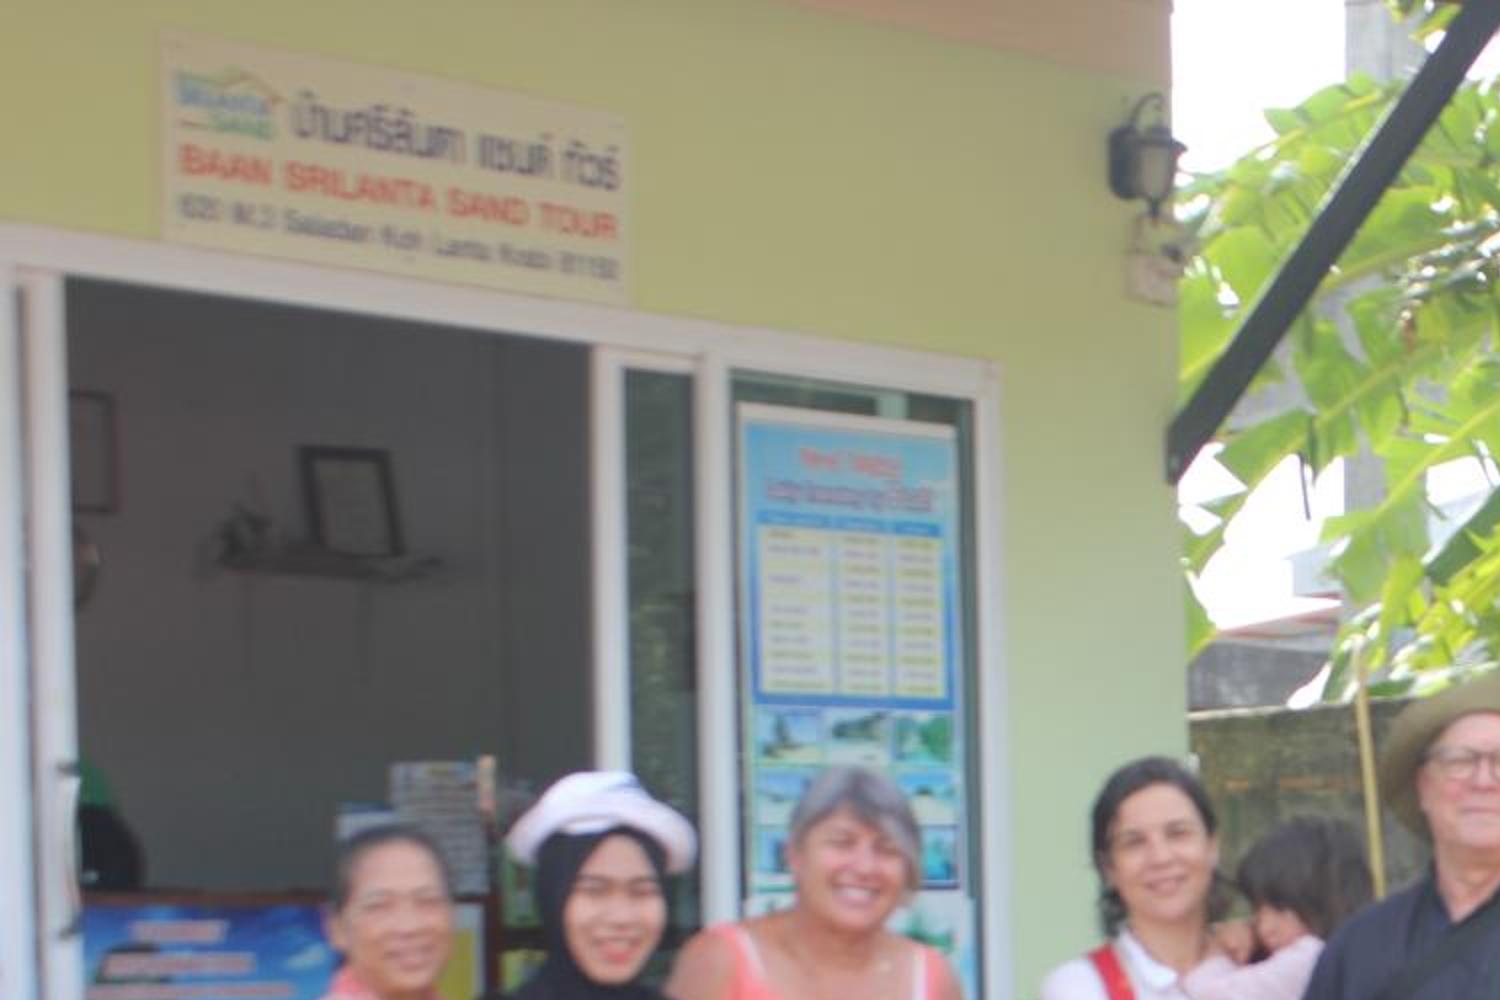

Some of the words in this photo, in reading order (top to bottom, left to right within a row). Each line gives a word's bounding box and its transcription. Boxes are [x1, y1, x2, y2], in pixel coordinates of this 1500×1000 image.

[180, 145, 273, 184] BAAN
[282, 160, 437, 214] SRILANTA
[446, 187, 529, 228] SAND
[539, 202, 618, 240] TOUR
